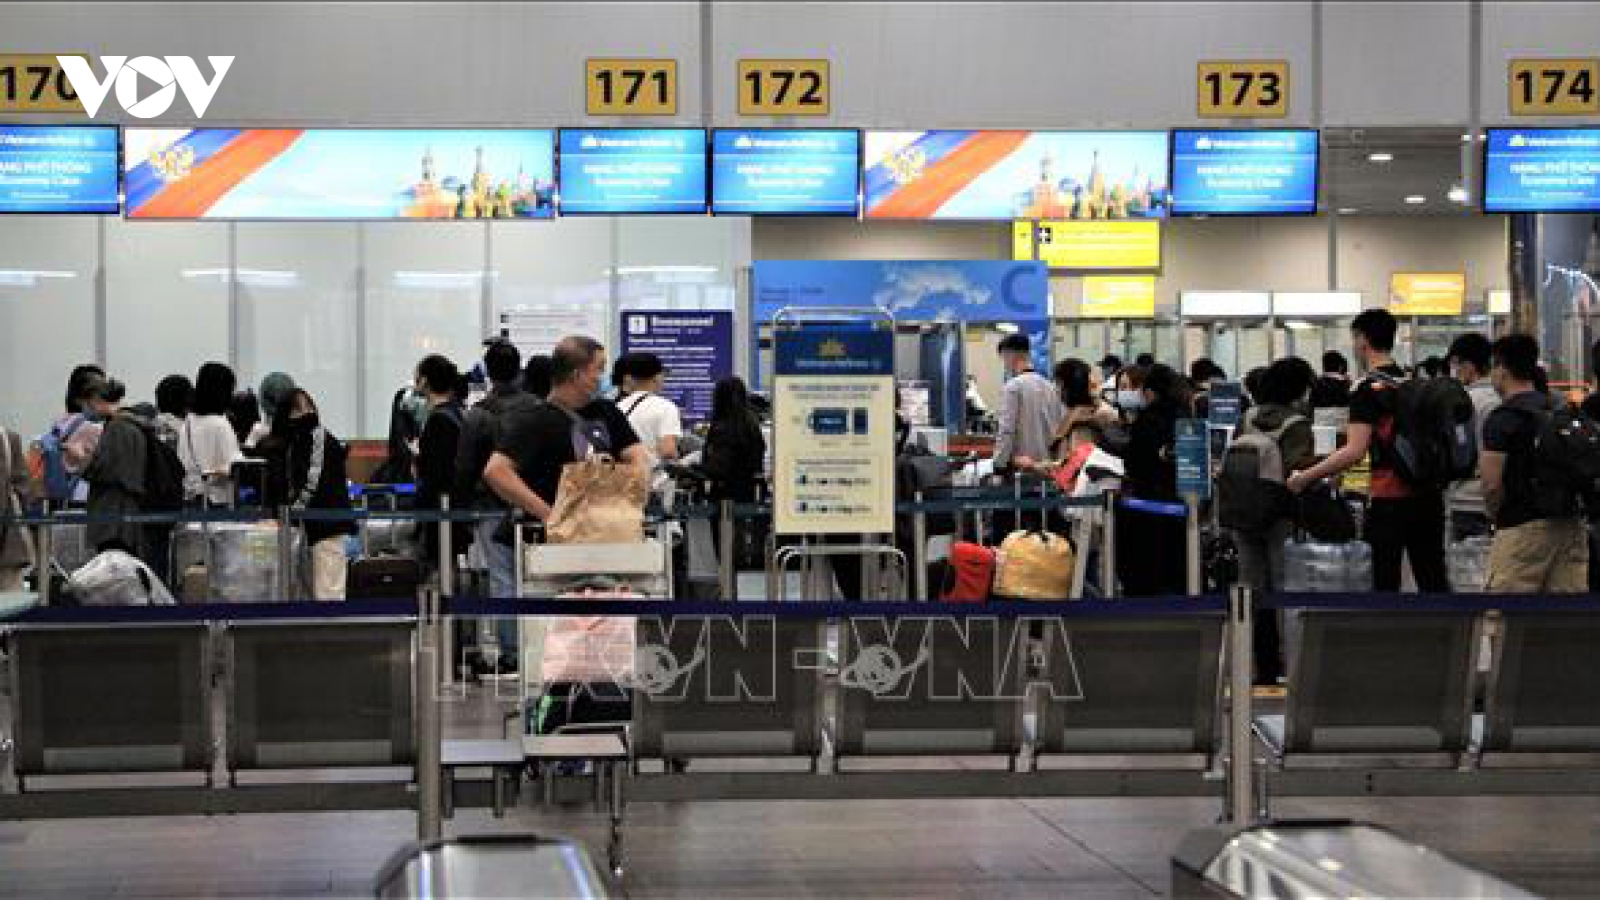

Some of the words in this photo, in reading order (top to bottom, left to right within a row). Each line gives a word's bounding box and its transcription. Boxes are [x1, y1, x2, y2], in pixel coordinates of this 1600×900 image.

[595, 69, 669, 105] 171
[745, 70, 823, 105] 172
[1204, 72, 1282, 106] 173
[1515, 70, 1593, 104] 174
[1001, 265, 1038, 313] C
